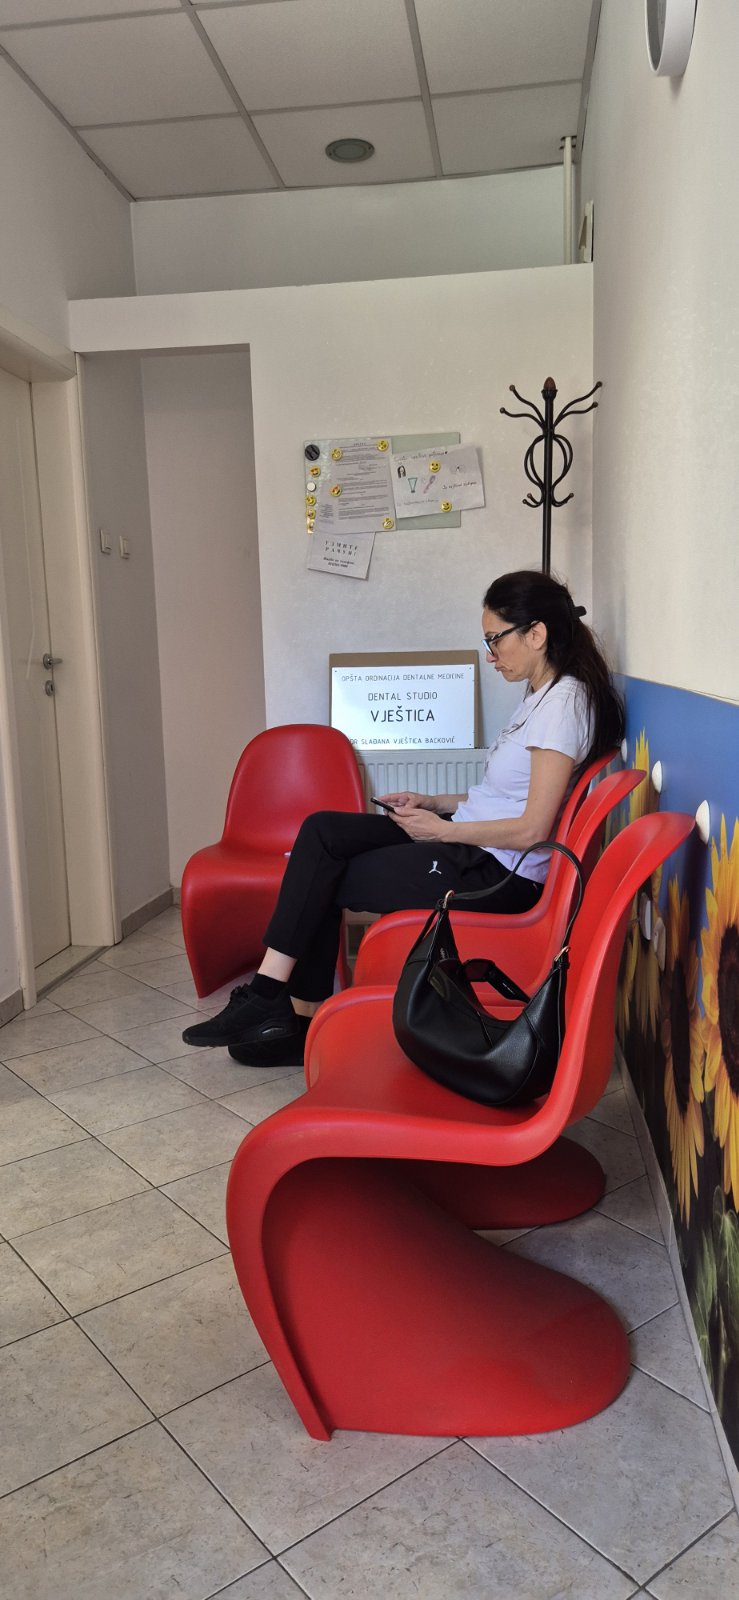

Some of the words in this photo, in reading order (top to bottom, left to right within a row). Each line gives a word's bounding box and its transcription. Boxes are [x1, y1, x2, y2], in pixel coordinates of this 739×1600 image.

[341, 674, 362, 682] OPŠTA
[365, 674, 400, 682] ORDINACIJA
[368, 692, 402, 701] DENTAL
[406, 691, 438, 700] STUDIO
[370, 705, 435, 723] VJEŠTICA
[393, 736, 422, 744] VJEŠTICA
